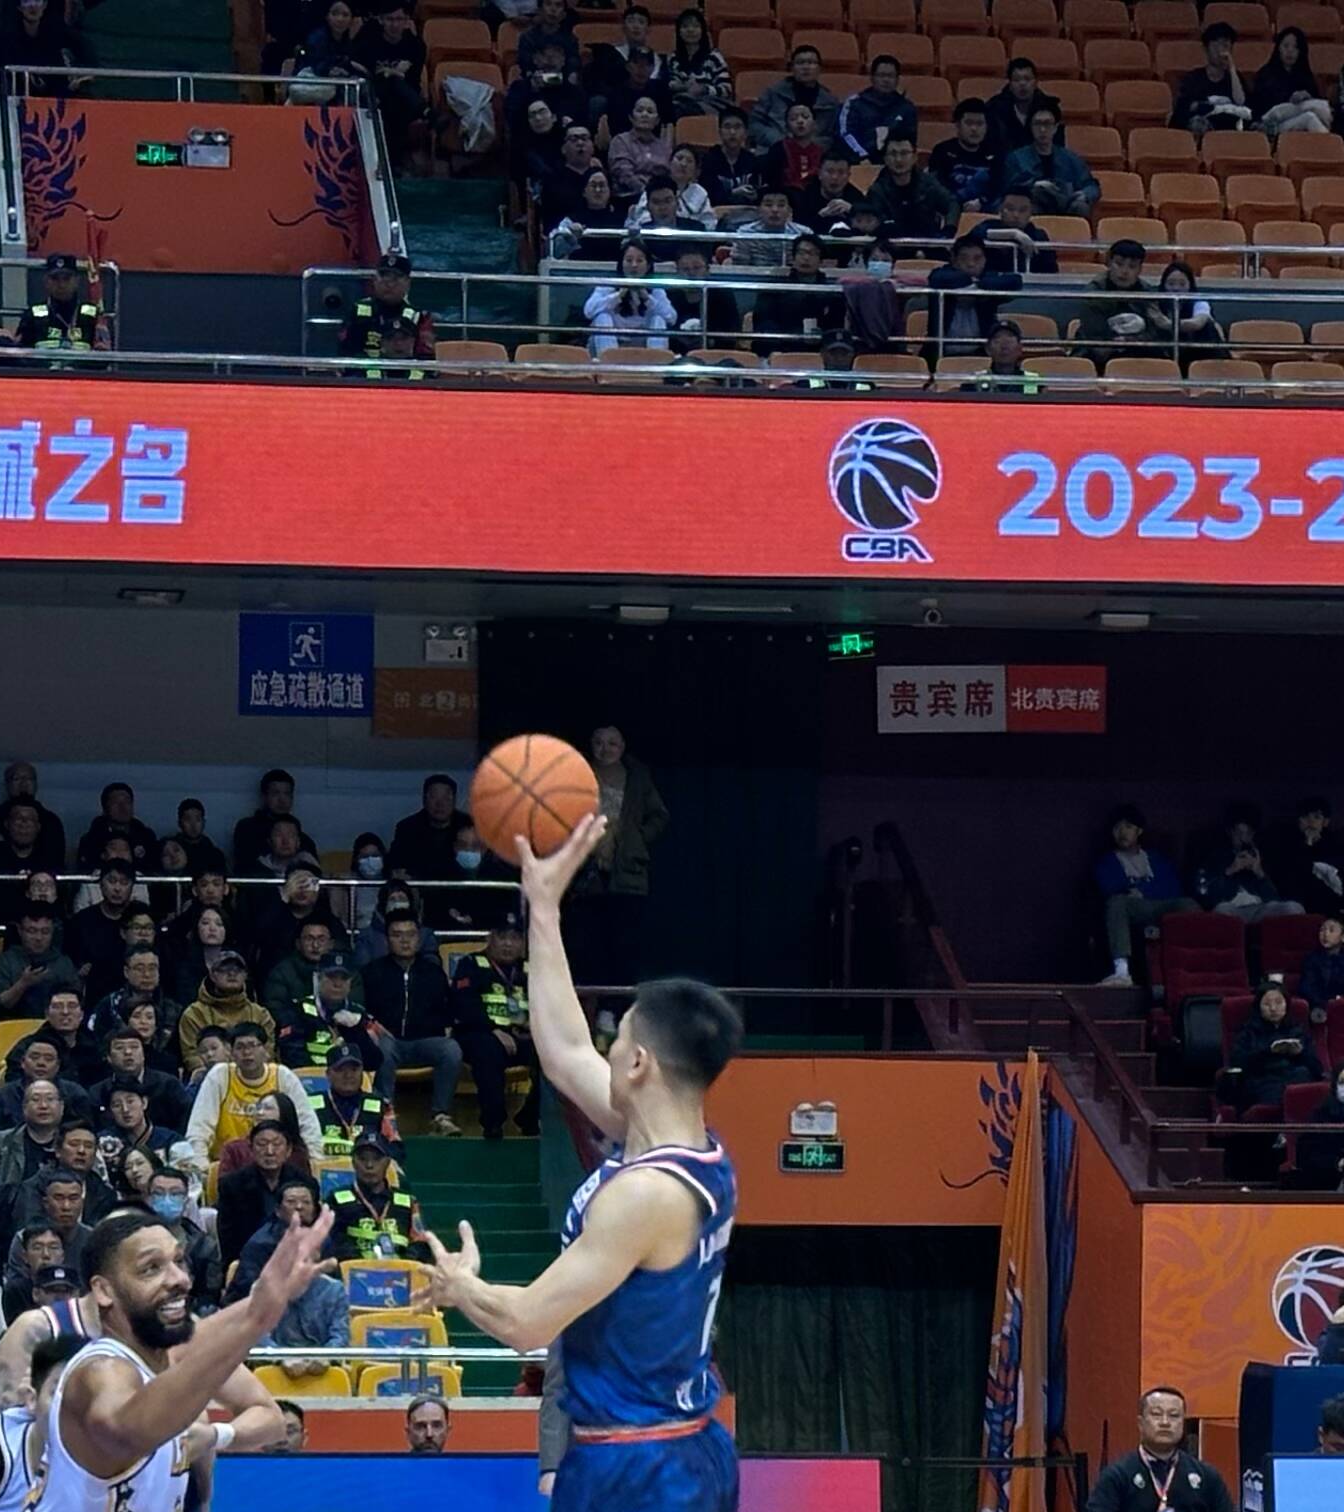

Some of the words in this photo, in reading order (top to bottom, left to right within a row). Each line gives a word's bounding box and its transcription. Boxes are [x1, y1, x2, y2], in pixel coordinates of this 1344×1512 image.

[841, 533, 934, 563] CBA
[250, 670, 364, 709] 应急疏散通道
[889, 680, 994, 718] 贵宾席
[1011, 687, 1100, 712] 北贵宾席
